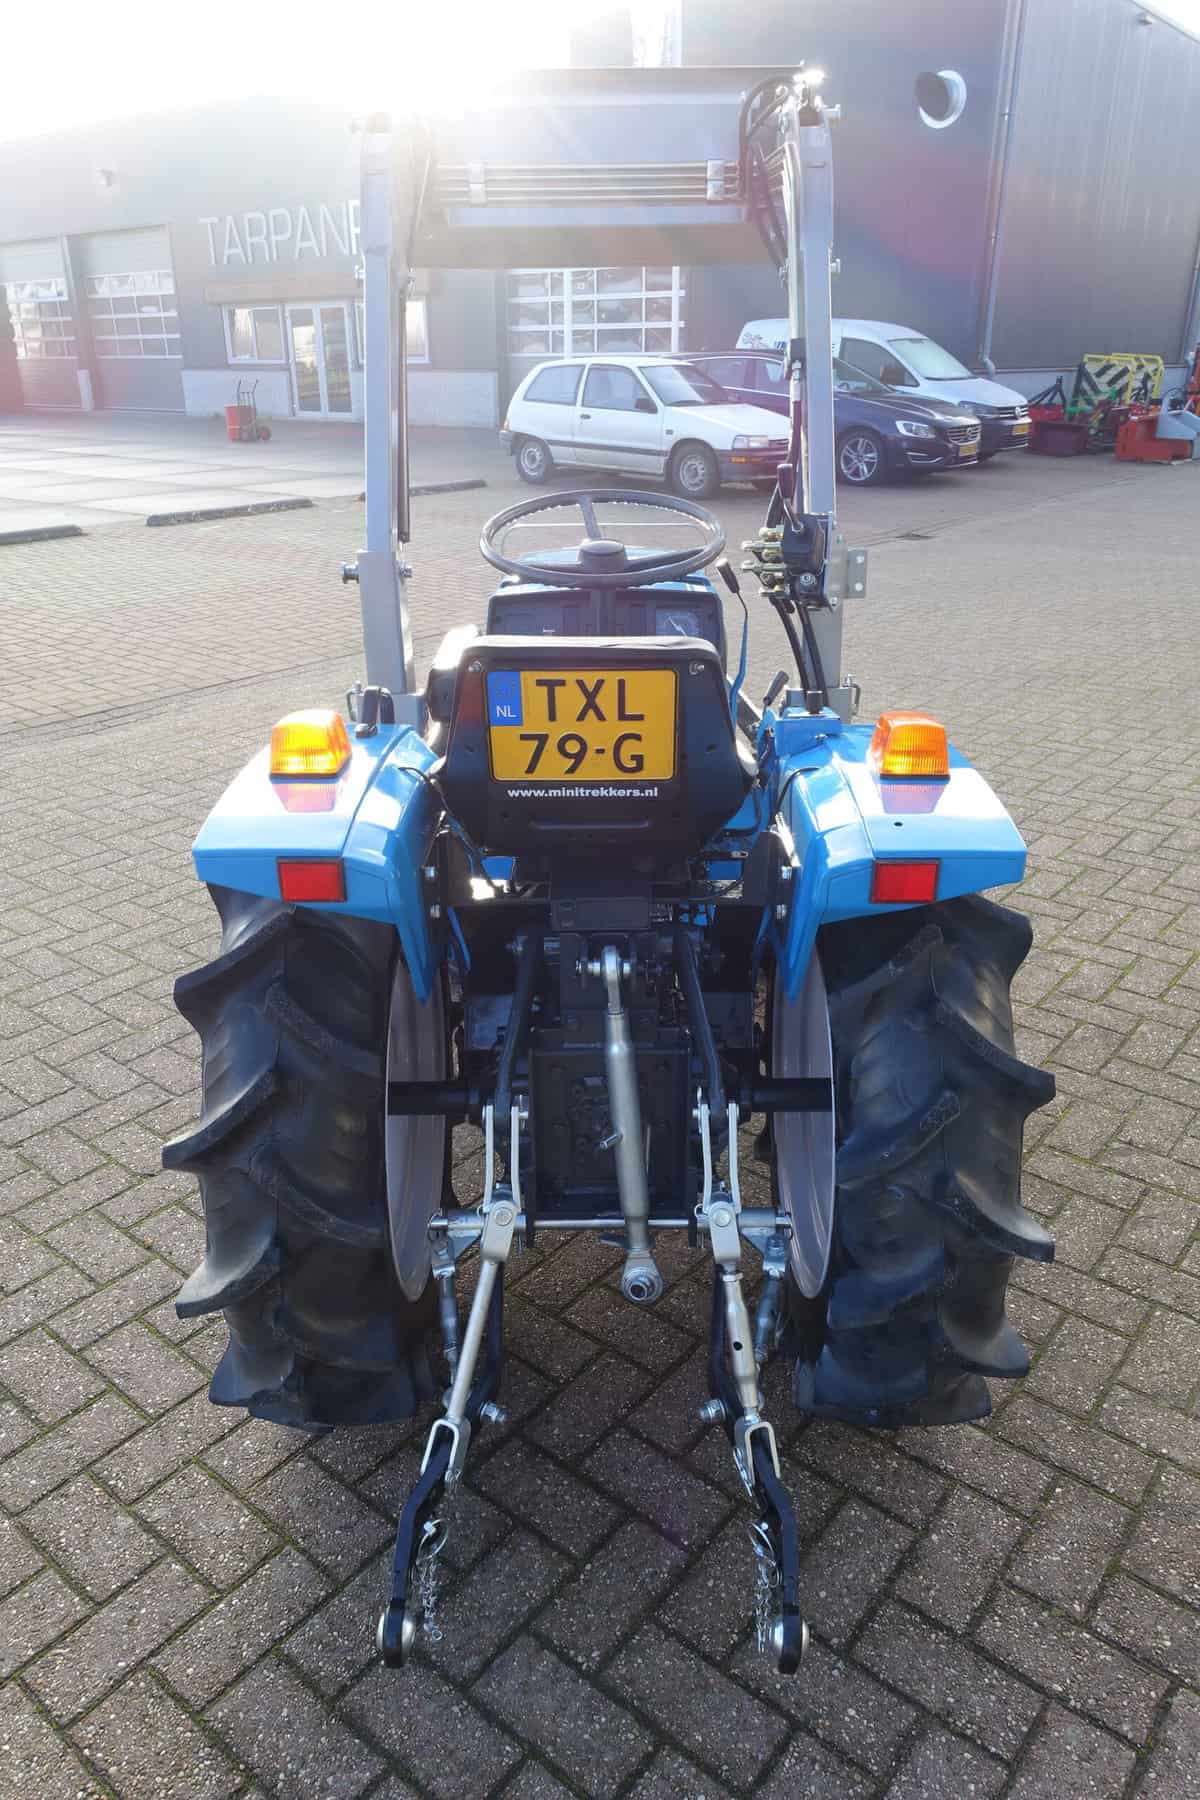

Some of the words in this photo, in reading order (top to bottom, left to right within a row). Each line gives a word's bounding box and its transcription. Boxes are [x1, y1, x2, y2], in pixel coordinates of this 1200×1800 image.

[495, 705, 517, 718] NL
[535, 678, 645, 722] TXL
[519, 732, 645, 775] 79-G
[507, 786, 658, 798] www.minitrekkers.nl
